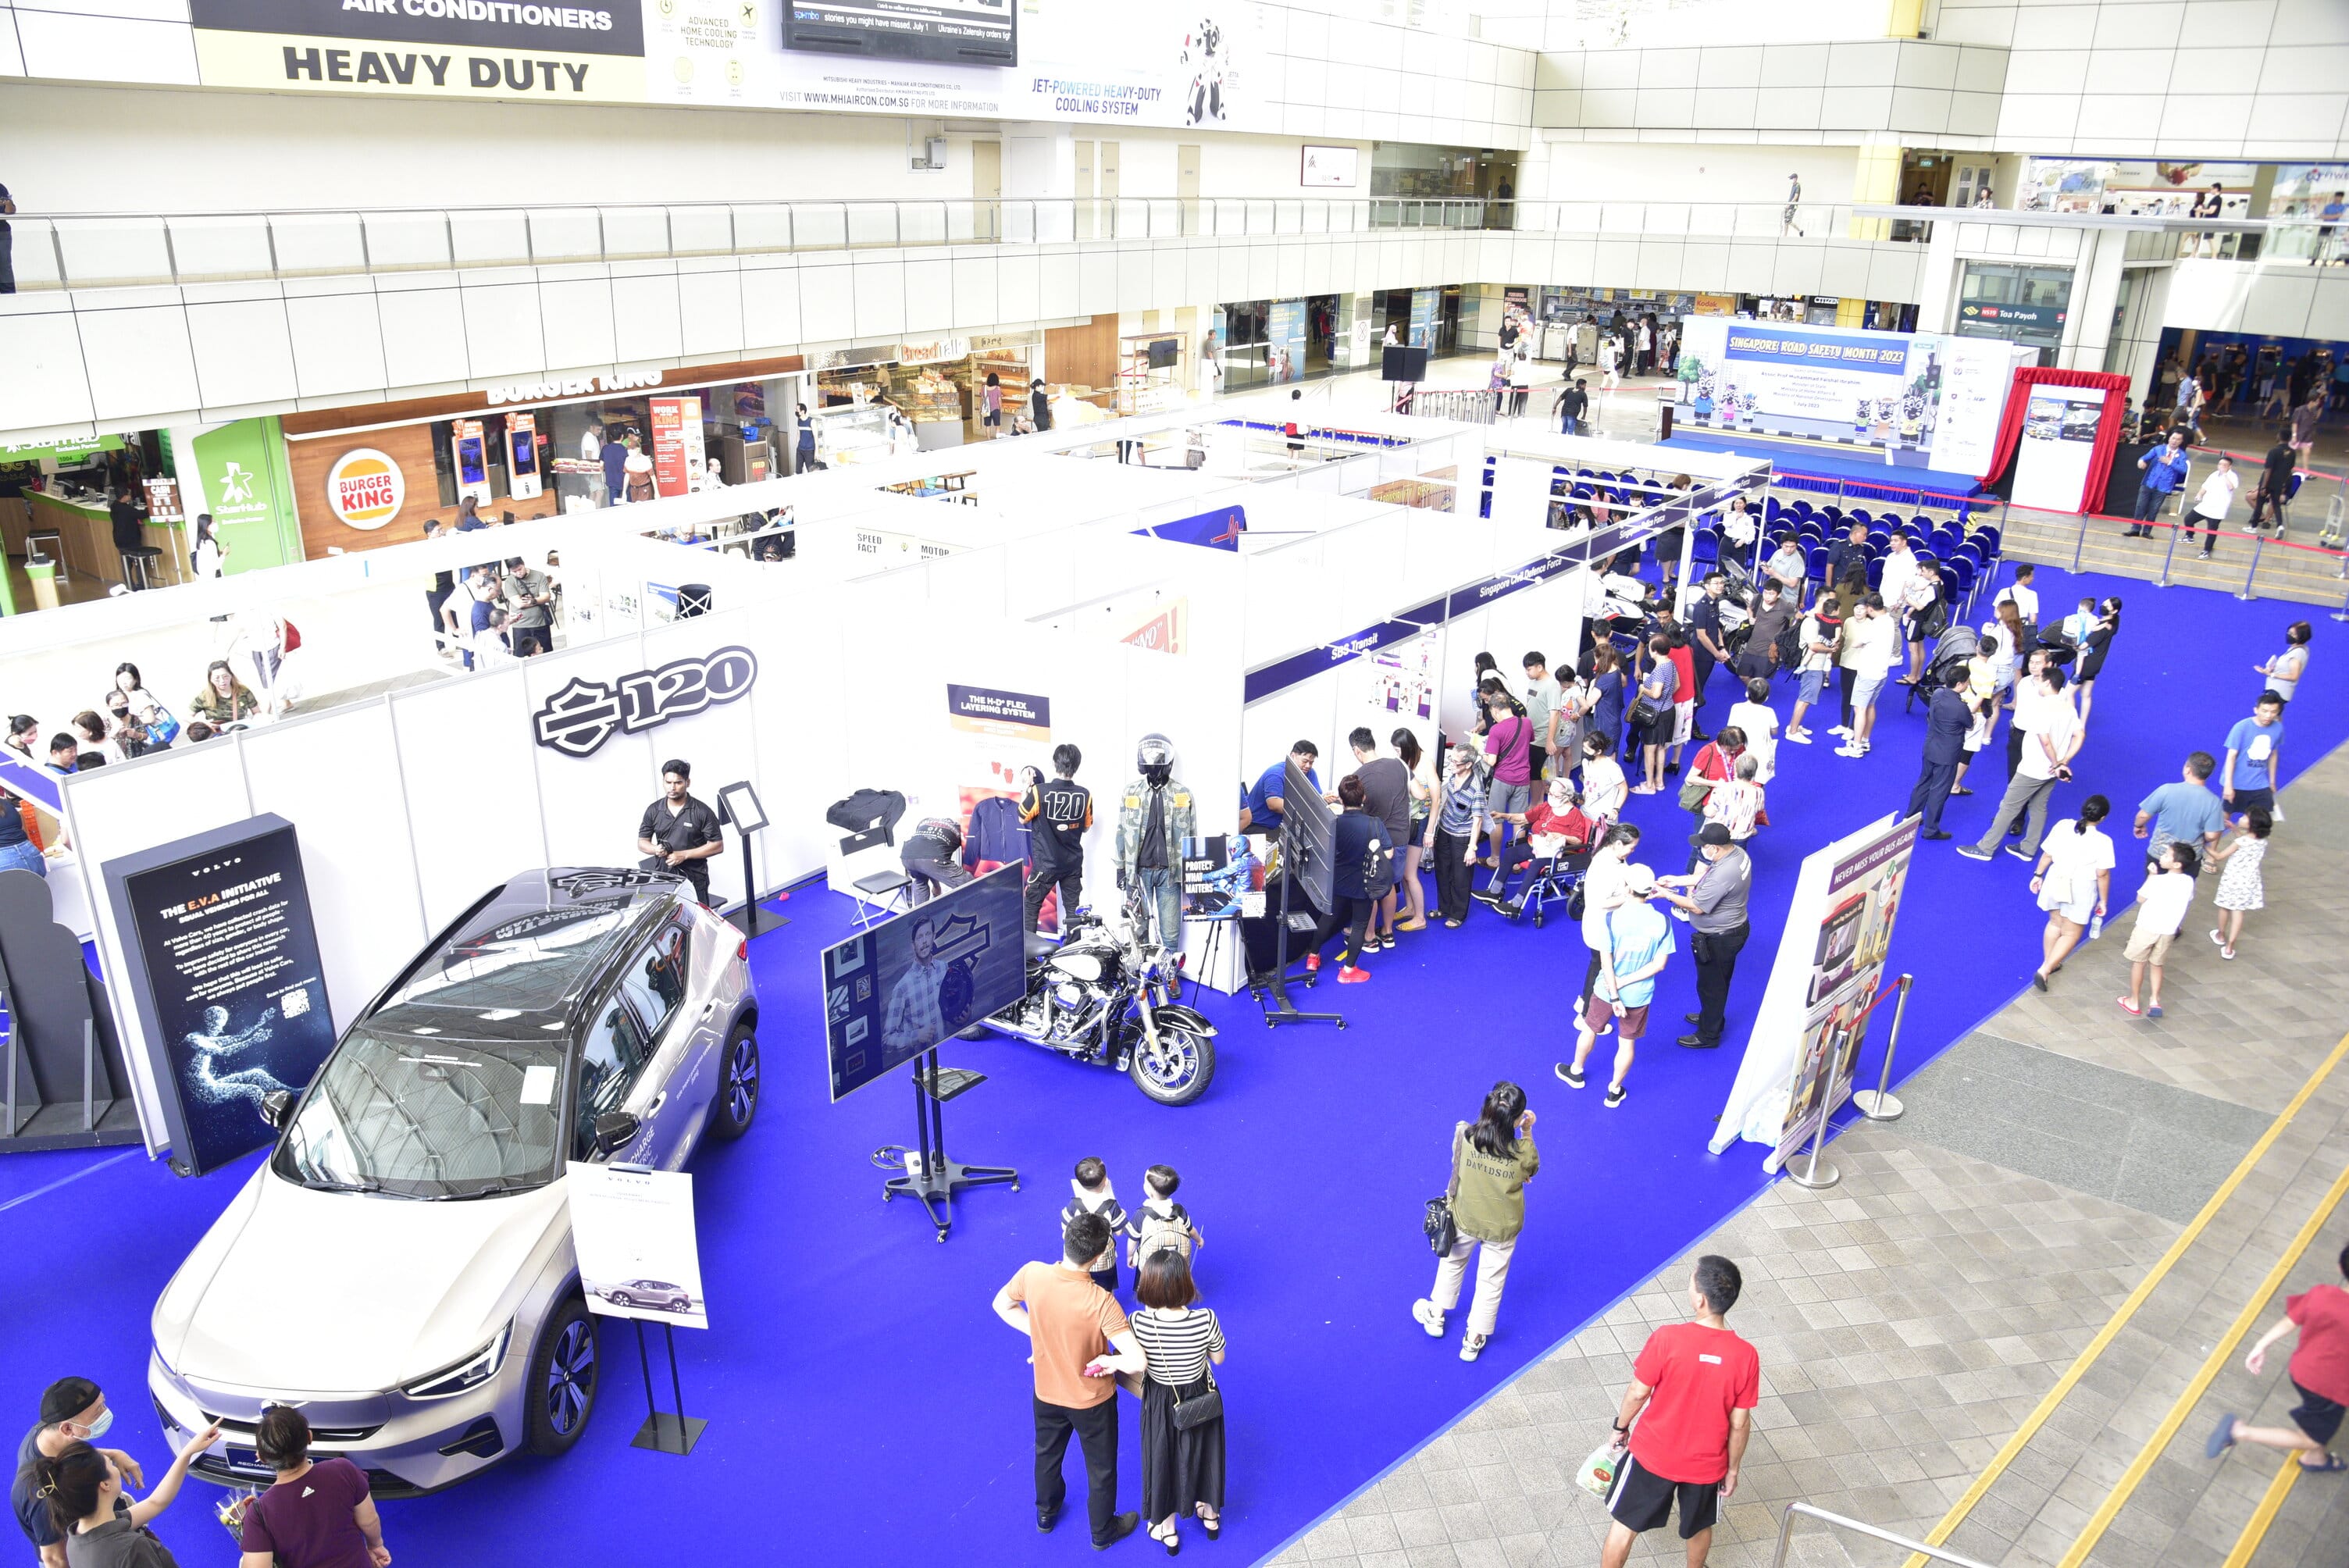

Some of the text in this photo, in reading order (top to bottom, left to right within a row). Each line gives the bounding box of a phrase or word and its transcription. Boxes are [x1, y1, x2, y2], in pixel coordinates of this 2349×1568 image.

[403, 0, 612, 32] CONDITIONERS
[689, 16, 729, 27] ADVANCED
[825, 14, 844, 23] stories
[847, 17, 857, 26] you
[858, 17, 874, 28] might
[890, 20, 912, 30] missed,
[913, 23, 924, 32] July
[681, 27, 702, 36] HOME
[705, 28, 737, 38] COOLING
[938, 24, 1001, 38] Ukraine's Zelensky orders
[686, 37, 734, 48] TECHNOLOGY
[282, 46, 590, 93] HEAVY DUTY
[1032, 78, 1162, 102] JET-POWERED HEAVY-DUTY
[780, 91, 998, 112] VISIT WWW.MHIAIRCON.COM.SG FOR MORE INFORMATION
[1056, 97, 1139, 116] COOLING SYSTEM
[2014, 312, 2037, 321] Payoh
[902, 337, 964, 363] BreadTalk
[1730, 337, 1905, 364] SINGAPORE ROAD SAFETY MONTH 2023
[654, 416, 679, 425] KING
[340, 475, 391, 494] BURGER
[216, 502, 267, 514] StarHub
[342, 488, 394, 511] KING
[857, 533, 882, 544] SPEED
[858, 543, 876, 554] FACT
[1480, 558, 1562, 597] Singapore Defence Force
[1331, 633, 1378, 661] SBS Transit
[622, 650, 754, 729] 120
[961, 702, 1035, 718] LAYERING SYSTEM
[969, 695, 1026, 709] THE FLEX
[1045, 791, 1085, 821] 120
[191, 857, 242, 877] VOLVO
[1185, 861, 1213, 871] PROTECT
[1834, 829, 1916, 885] NEVER MISS YOUR BUS AGAIN!
[1185, 872, 1203, 882] WHAT
[160, 872, 282, 919] THE E.V.A INITIATIVE
[1185, 884, 1214, 893] MATTERS
[178, 889, 269, 924] EQUAL VEHICLES FOR ALL
[171, 935, 188, 944] Volvo
[213, 921, 227, 930] have
[227, 913, 252, 925] collected
[252, 907, 268, 917] crash
[212, 928, 227, 938] years
[234, 918, 255, 929] protect
[262, 910, 280, 921] people
[175, 916, 285, 957] regardless body shape.
[184, 957, 207, 969] improve
[207, 950, 224, 960] safety
[233, 938, 258, 950] everyone
[265, 930, 279, 939] every
[193, 963, 207, 971] have
[207, 954, 230, 967] decided
[236, 947, 252, 957] share
[262, 935, 286, 946] research
[255, 945, 278, 957] industry.
[203, 979, 218, 989] hope
[218, 974, 230, 982] that
[230, 970, 241, 978] this
[251, 961, 264, 971] lead
[270, 955, 283, 964] safer
[185, 993, 199, 1002] cars
[234, 971, 258, 984] Because
[264, 964, 280, 974] Volvo
[216, 975, 265, 997] always put people
[266, 990, 279, 999] Scan
[1467, 1159, 1515, 1179] DAVIDSON
[608, 1176, 651, 1185] VOLVO
